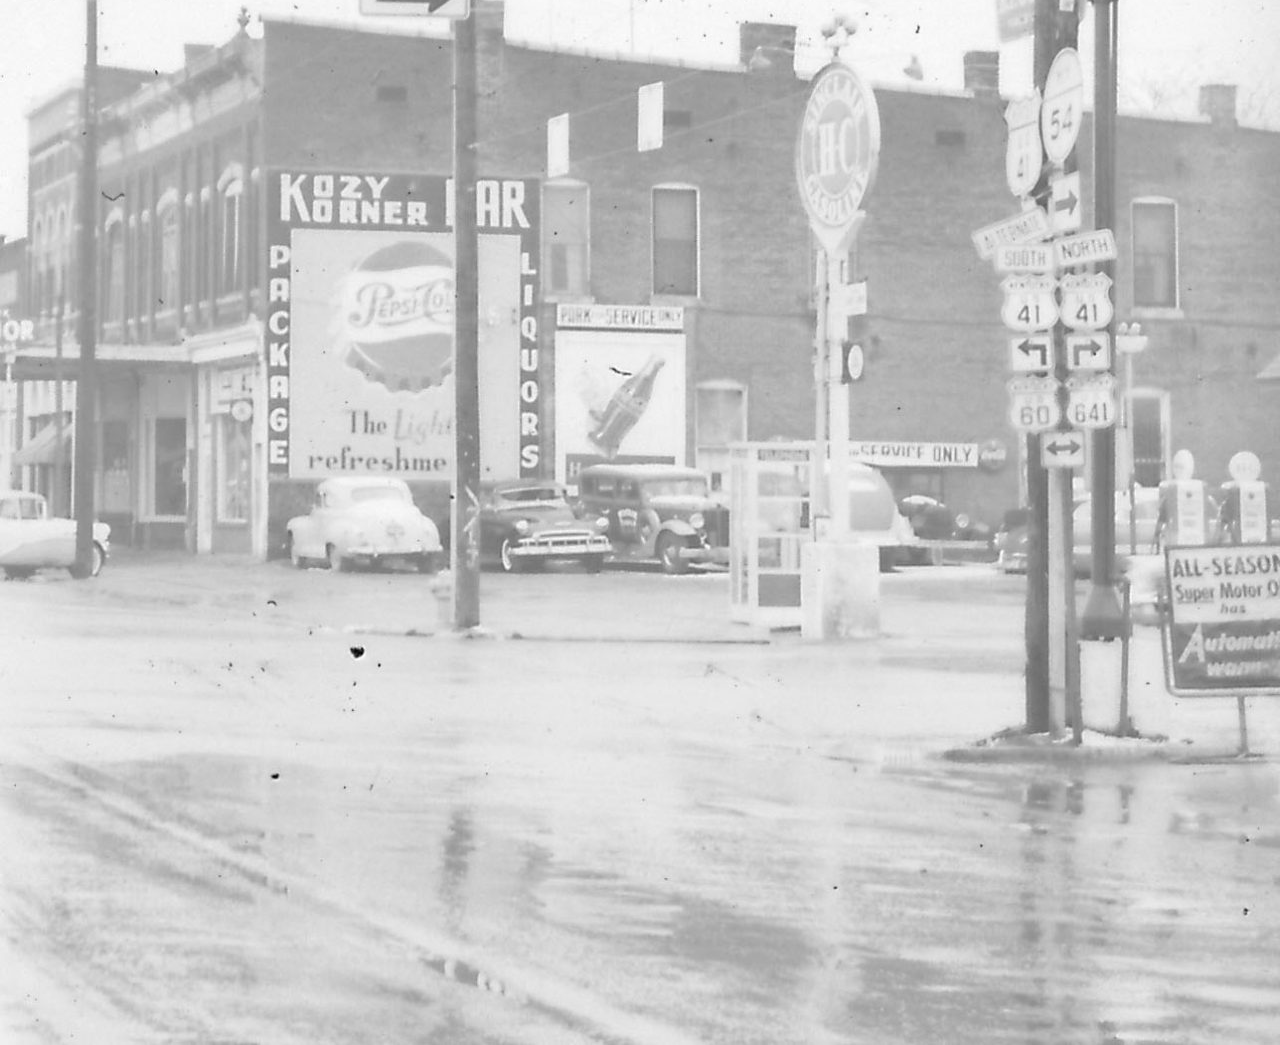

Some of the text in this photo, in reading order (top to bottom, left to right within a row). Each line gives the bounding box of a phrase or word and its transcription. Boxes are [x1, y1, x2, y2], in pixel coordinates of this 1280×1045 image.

[1050, 101, 1074, 141] 54
[1004, 249, 1047, 267] SOUTH
[1062, 238, 1109, 259] NORTH
[606, 307, 656, 327] SERVICE
[1017, 305, 1041, 324] 41
[1076, 304, 1098, 323] 41
[269, 244, 290, 464] PACKAGE
[520, 251, 539, 469] LIQUORS
[345, 409, 388, 435] The
[1020, 406, 1050, 426] 60
[1075, 402, 1108, 423] 641
[307, 445, 448, 472] refreshme
[860, 444, 925, 460] SERVICE
[932, 444, 972, 463] ONLY
[1175, 578, 1280, 603] Super Motor O
[1178, 623, 1280, 664] Automati
